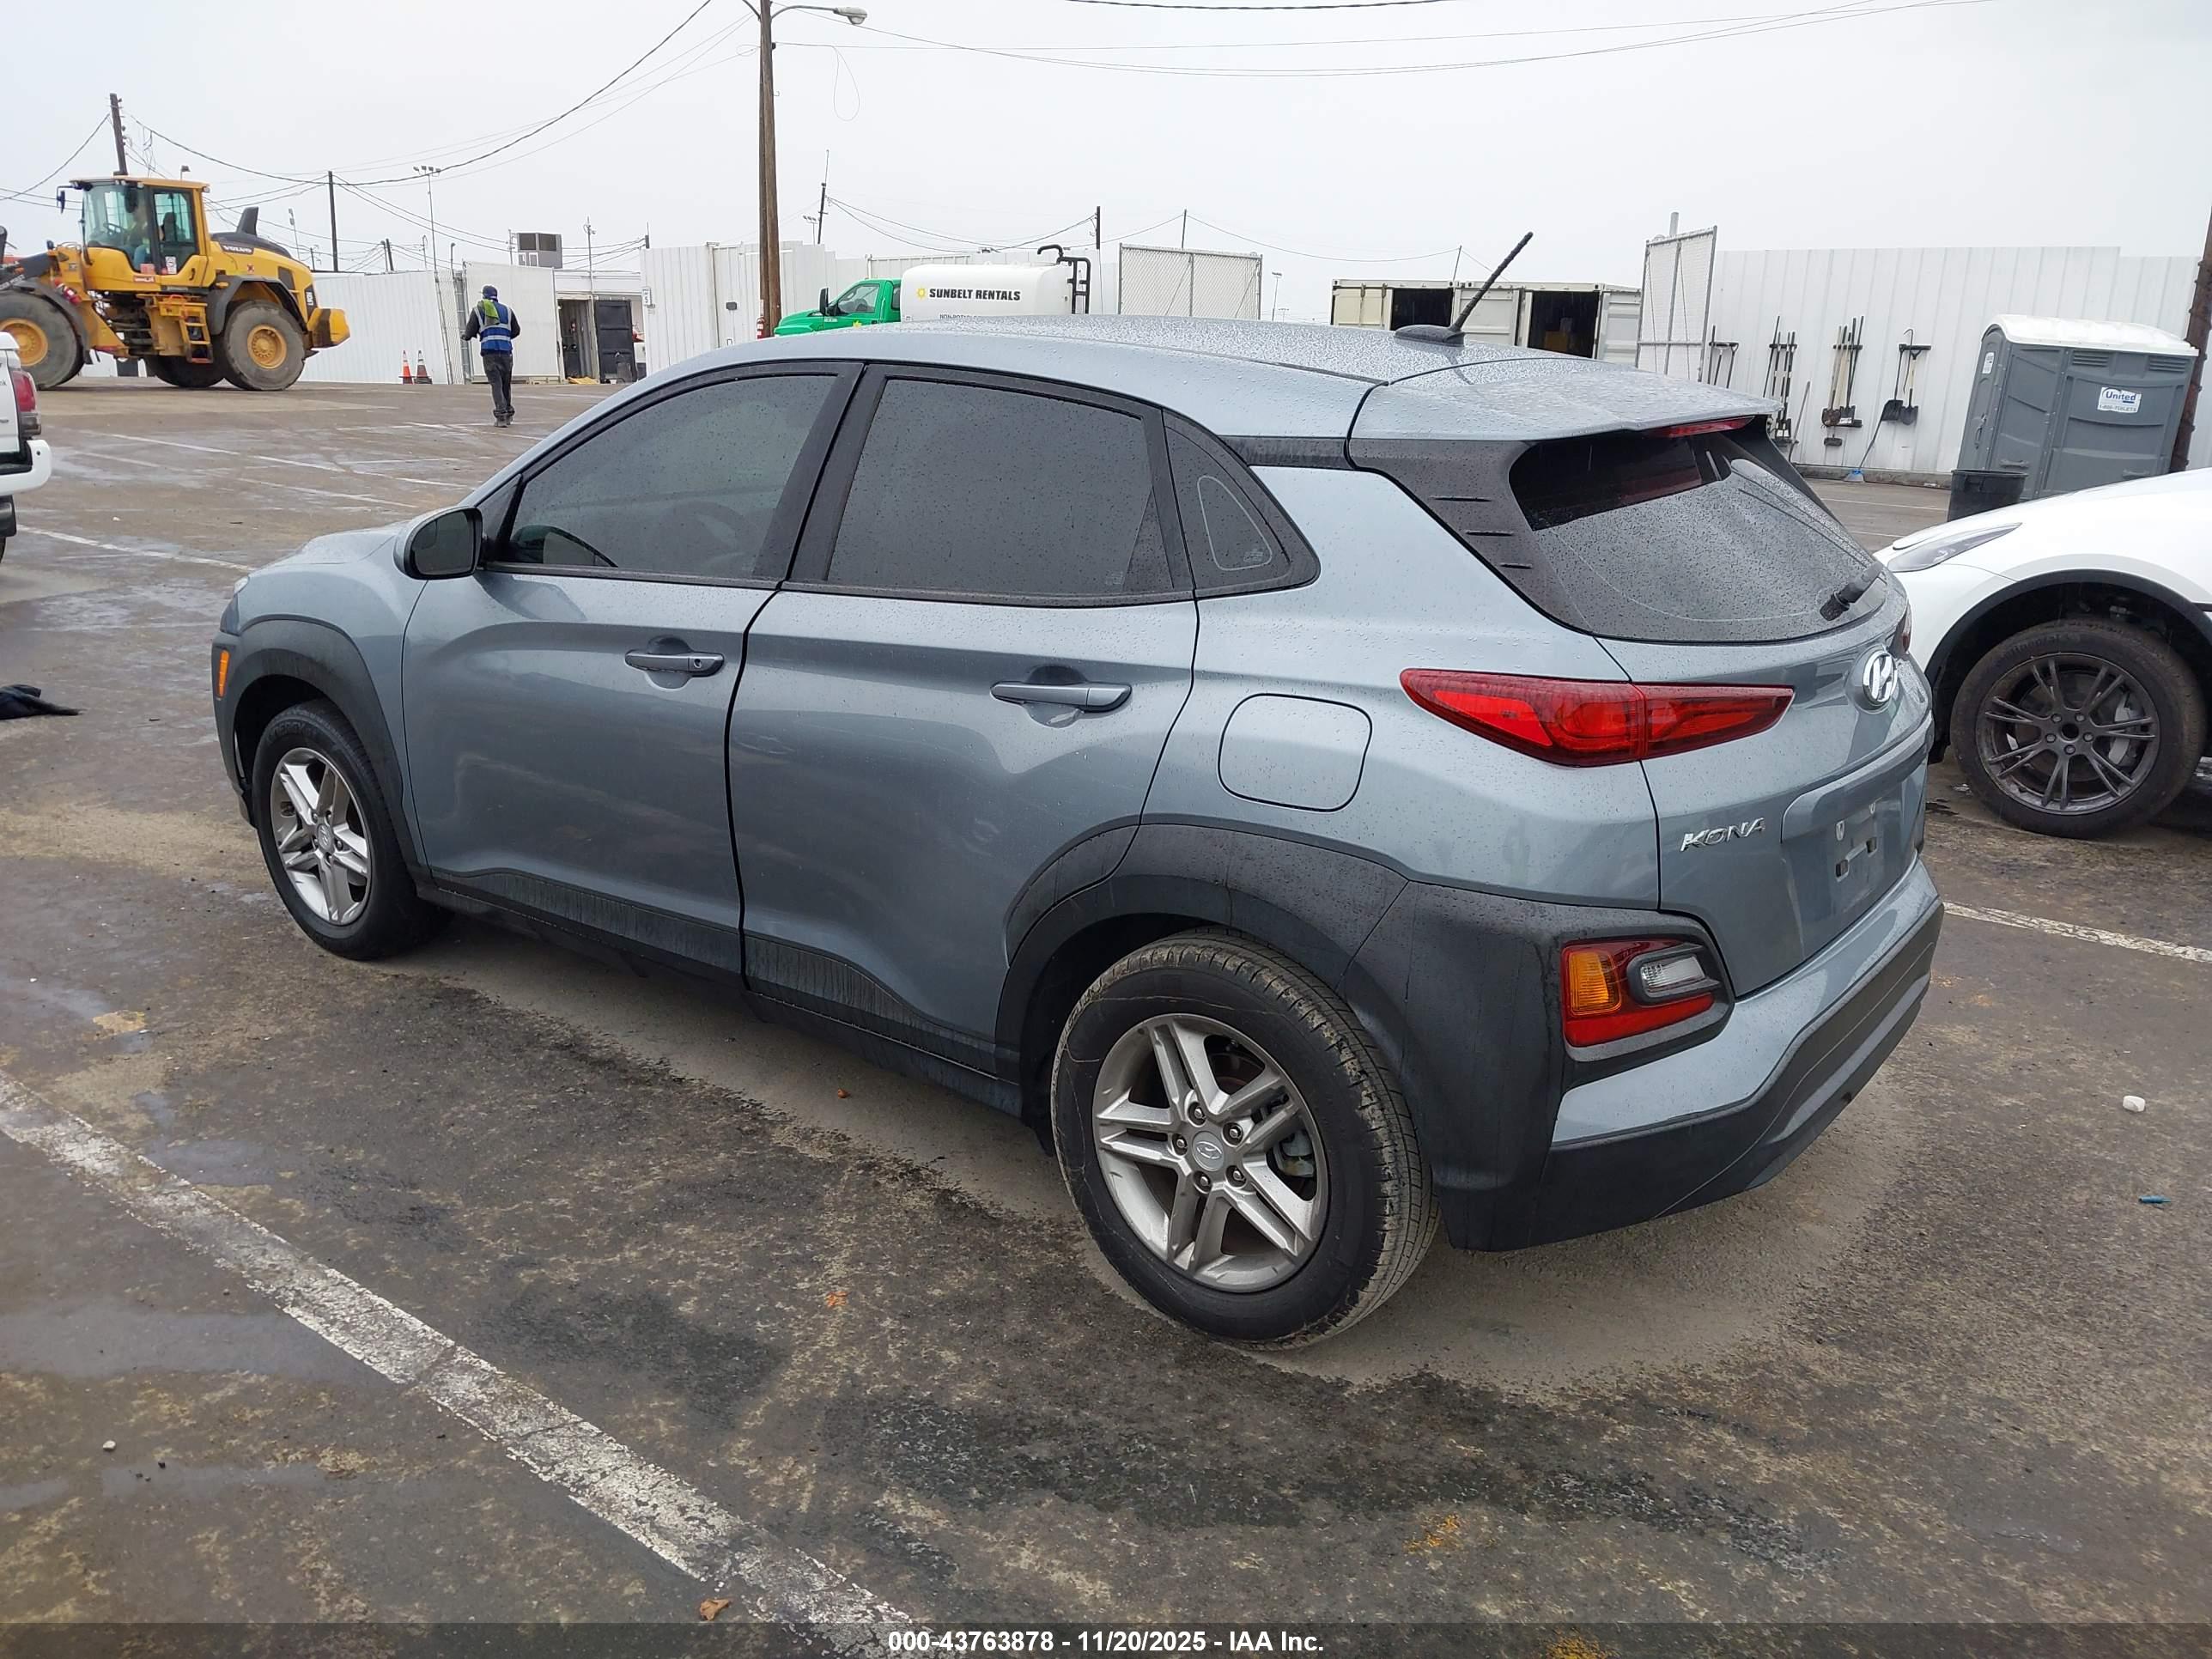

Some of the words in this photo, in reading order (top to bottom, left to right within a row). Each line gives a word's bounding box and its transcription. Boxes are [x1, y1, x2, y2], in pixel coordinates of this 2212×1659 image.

[222, 245, 252, 253] VOLVO
[929, 289, 973, 299] SUNBELT
[975, 289, 1021, 301] RENTALS
[2106, 391, 2136, 401] United
[1680, 817, 1765, 852] KONA
